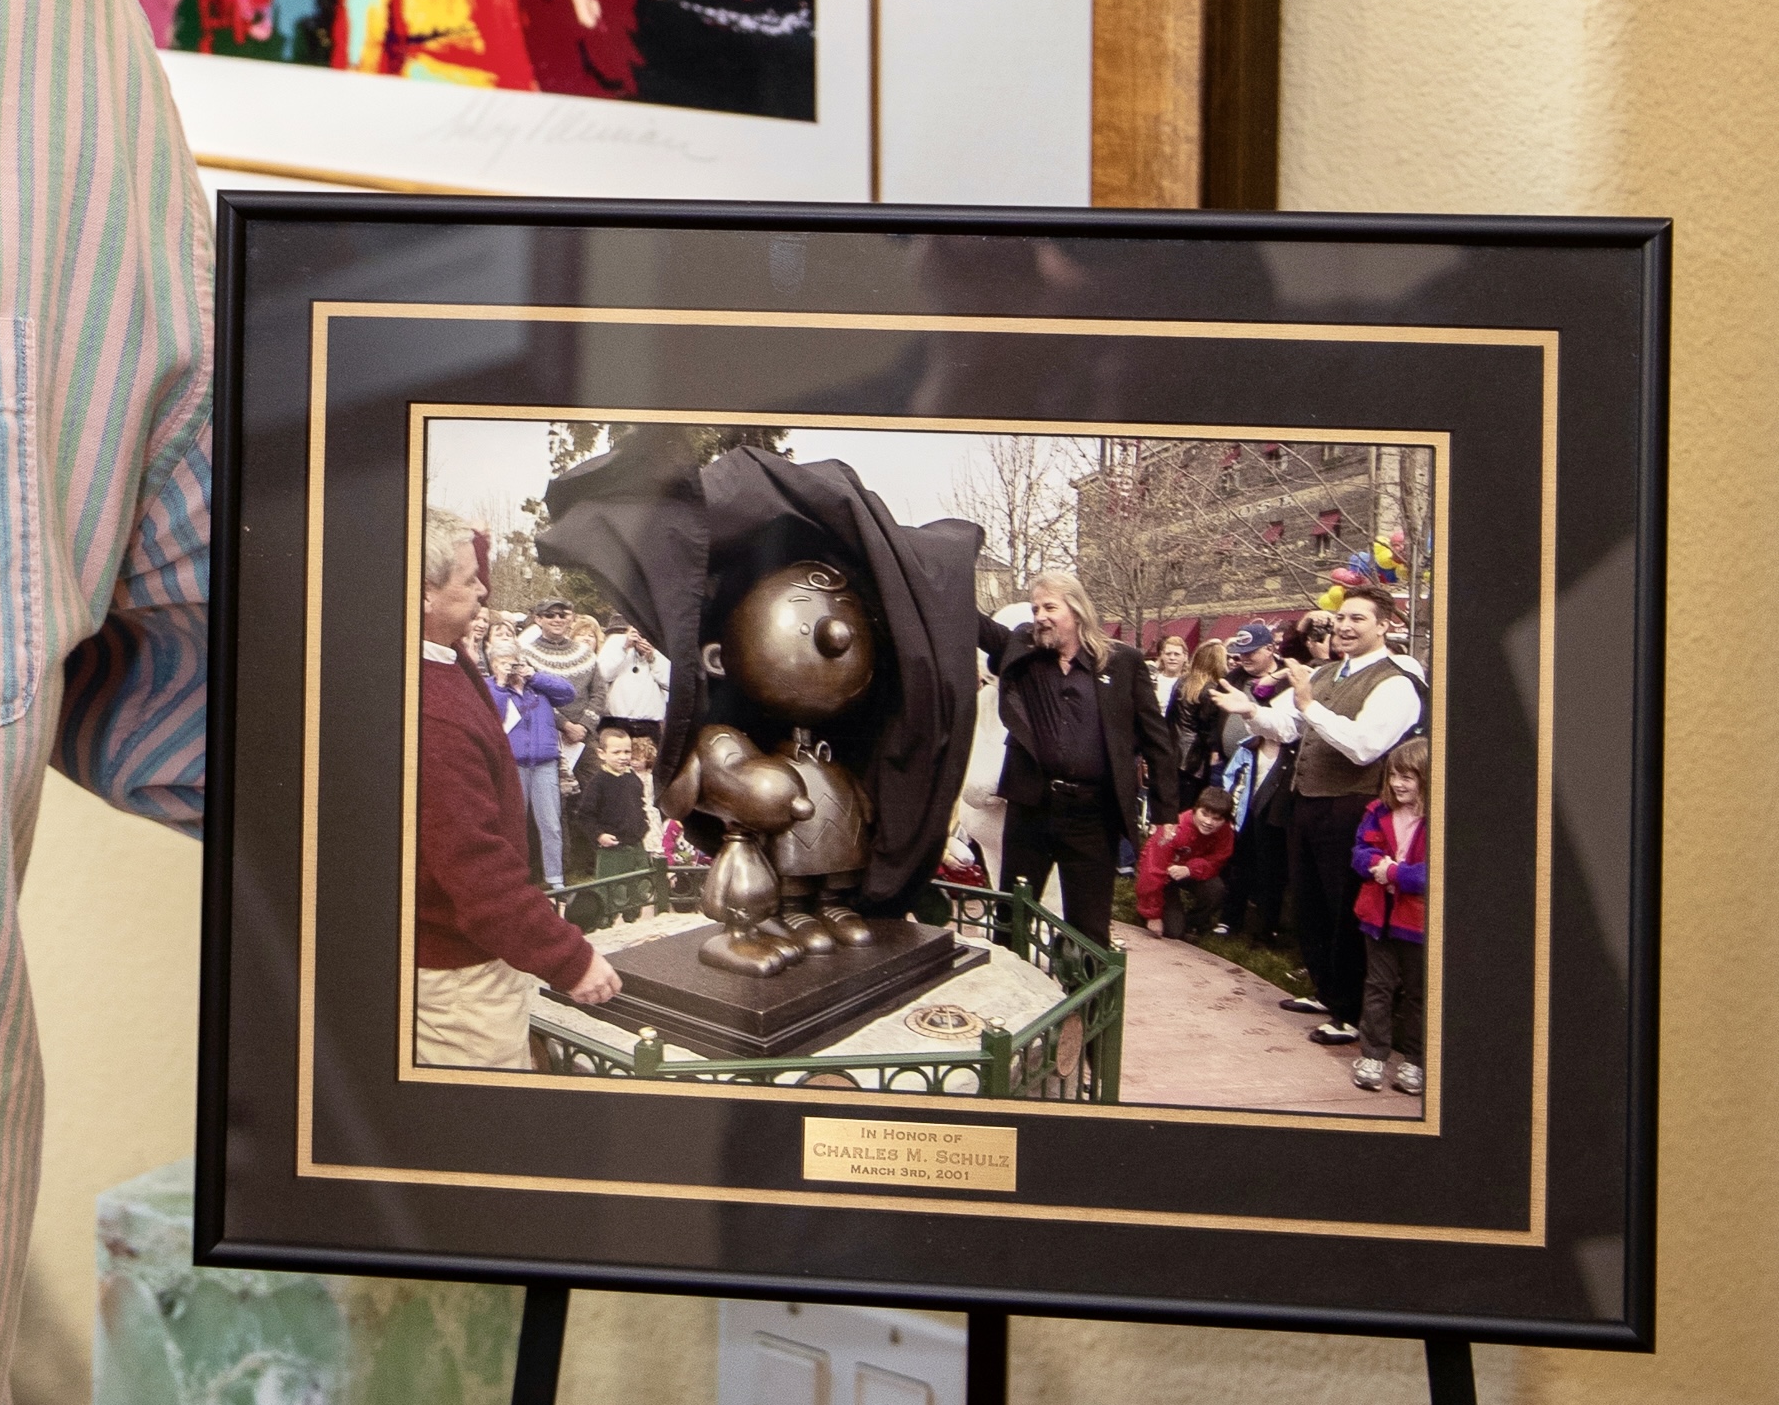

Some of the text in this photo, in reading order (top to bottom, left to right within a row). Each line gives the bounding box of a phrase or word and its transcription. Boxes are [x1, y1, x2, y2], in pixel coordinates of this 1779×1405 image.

[860, 1126, 963, 1143] IN HONOR OF
[812, 1142, 1010, 1168] CHARLES M. SCHULZ
[850, 1164, 969, 1181] MARCH 3RD, 2001
